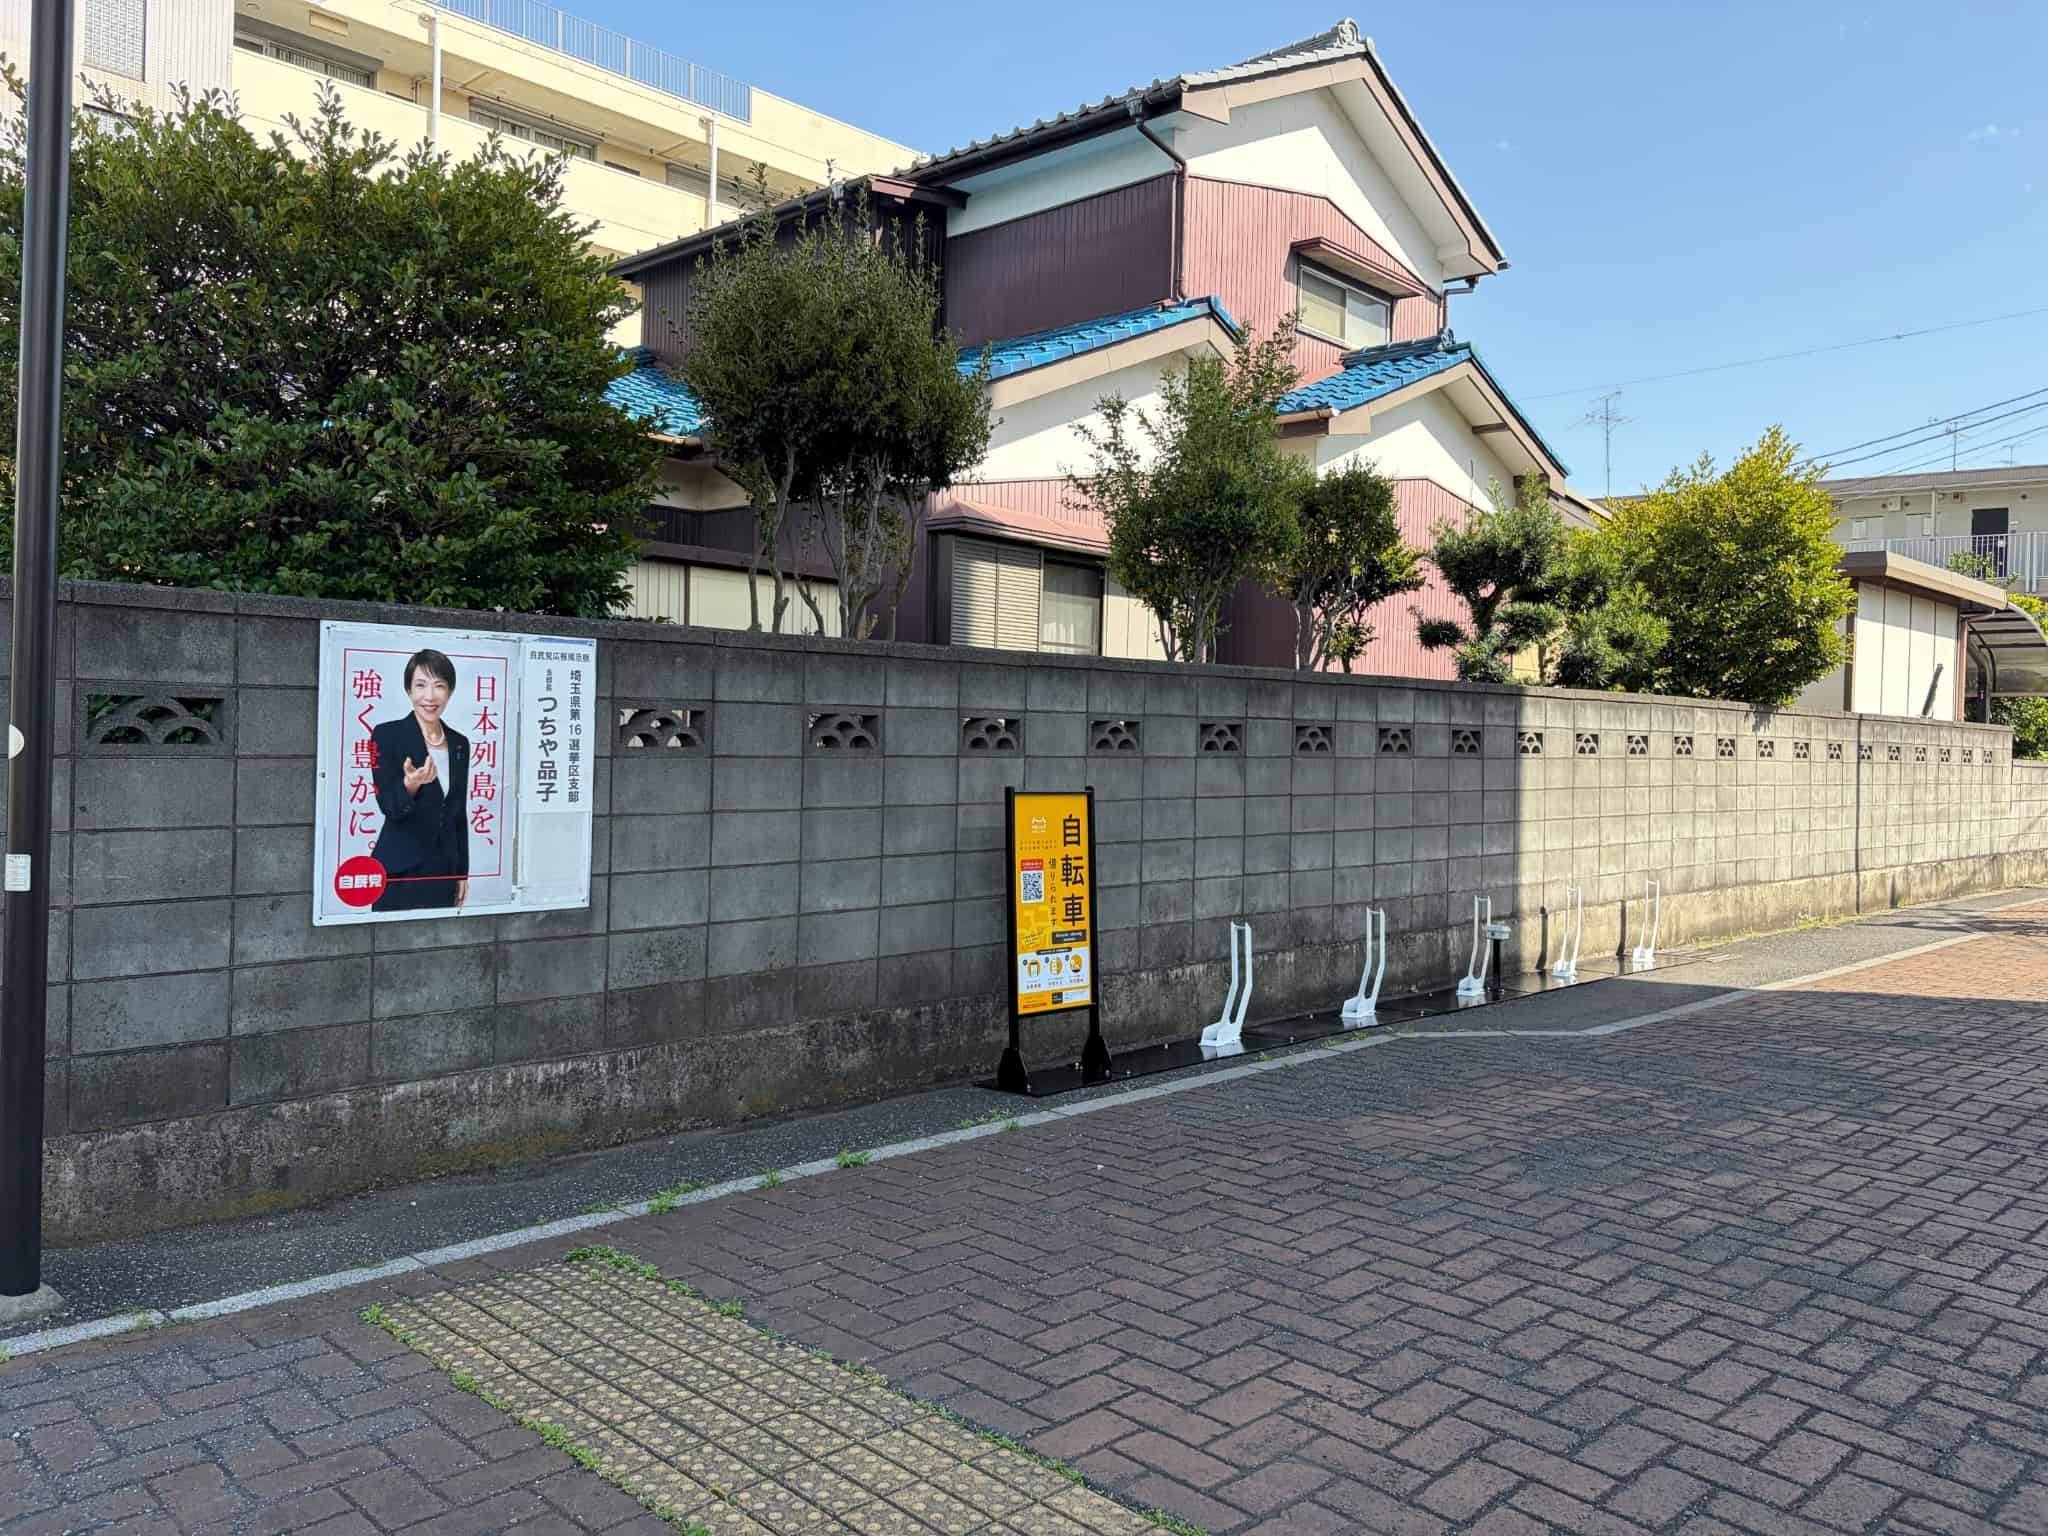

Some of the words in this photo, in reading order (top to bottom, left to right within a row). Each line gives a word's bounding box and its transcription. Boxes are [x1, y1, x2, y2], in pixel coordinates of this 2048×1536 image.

[349, 669, 383, 850] 強く豊かに。
[470, 675, 498, 846] 日本列島を、
[536, 696, 559, 802] つちや品子
[568, 669, 582, 803] 埼玉県第16選挙区支部
[1060, 813, 1085, 927] 自転車
